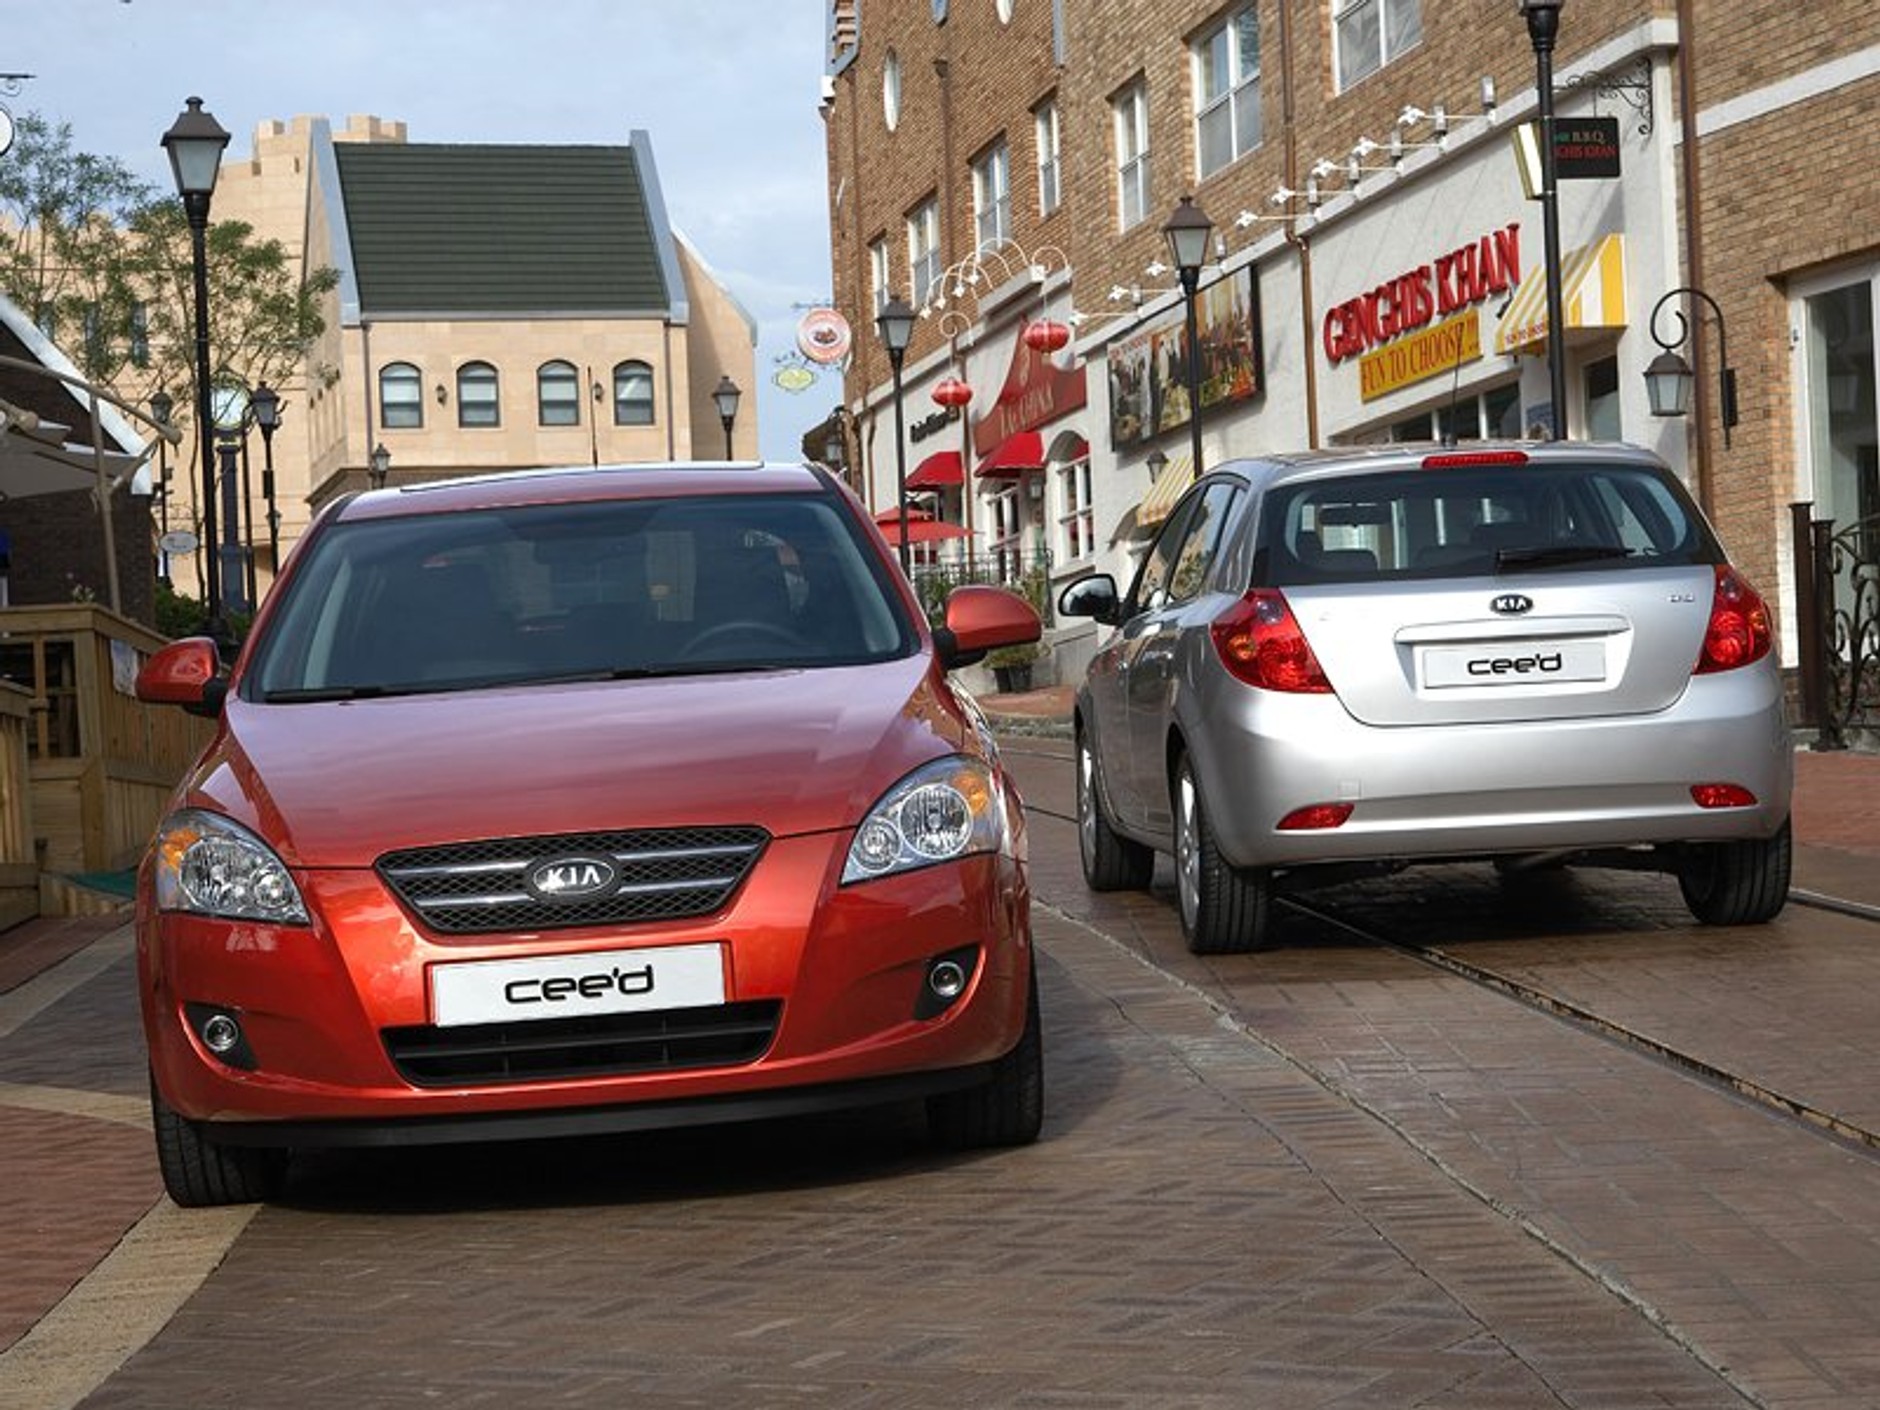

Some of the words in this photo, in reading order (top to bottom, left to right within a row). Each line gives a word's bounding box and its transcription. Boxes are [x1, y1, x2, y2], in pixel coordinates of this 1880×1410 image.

[1323, 266, 1433, 363] GENGHIS
[1434, 223, 1521, 315] KHAN
[1390, 342, 1407, 380] TO
[1496, 597, 1529, 612] KIA
[1467, 652, 1562, 676] cee'd
[538, 866, 601, 893] KIA
[504, 963, 655, 1005] cee'd
